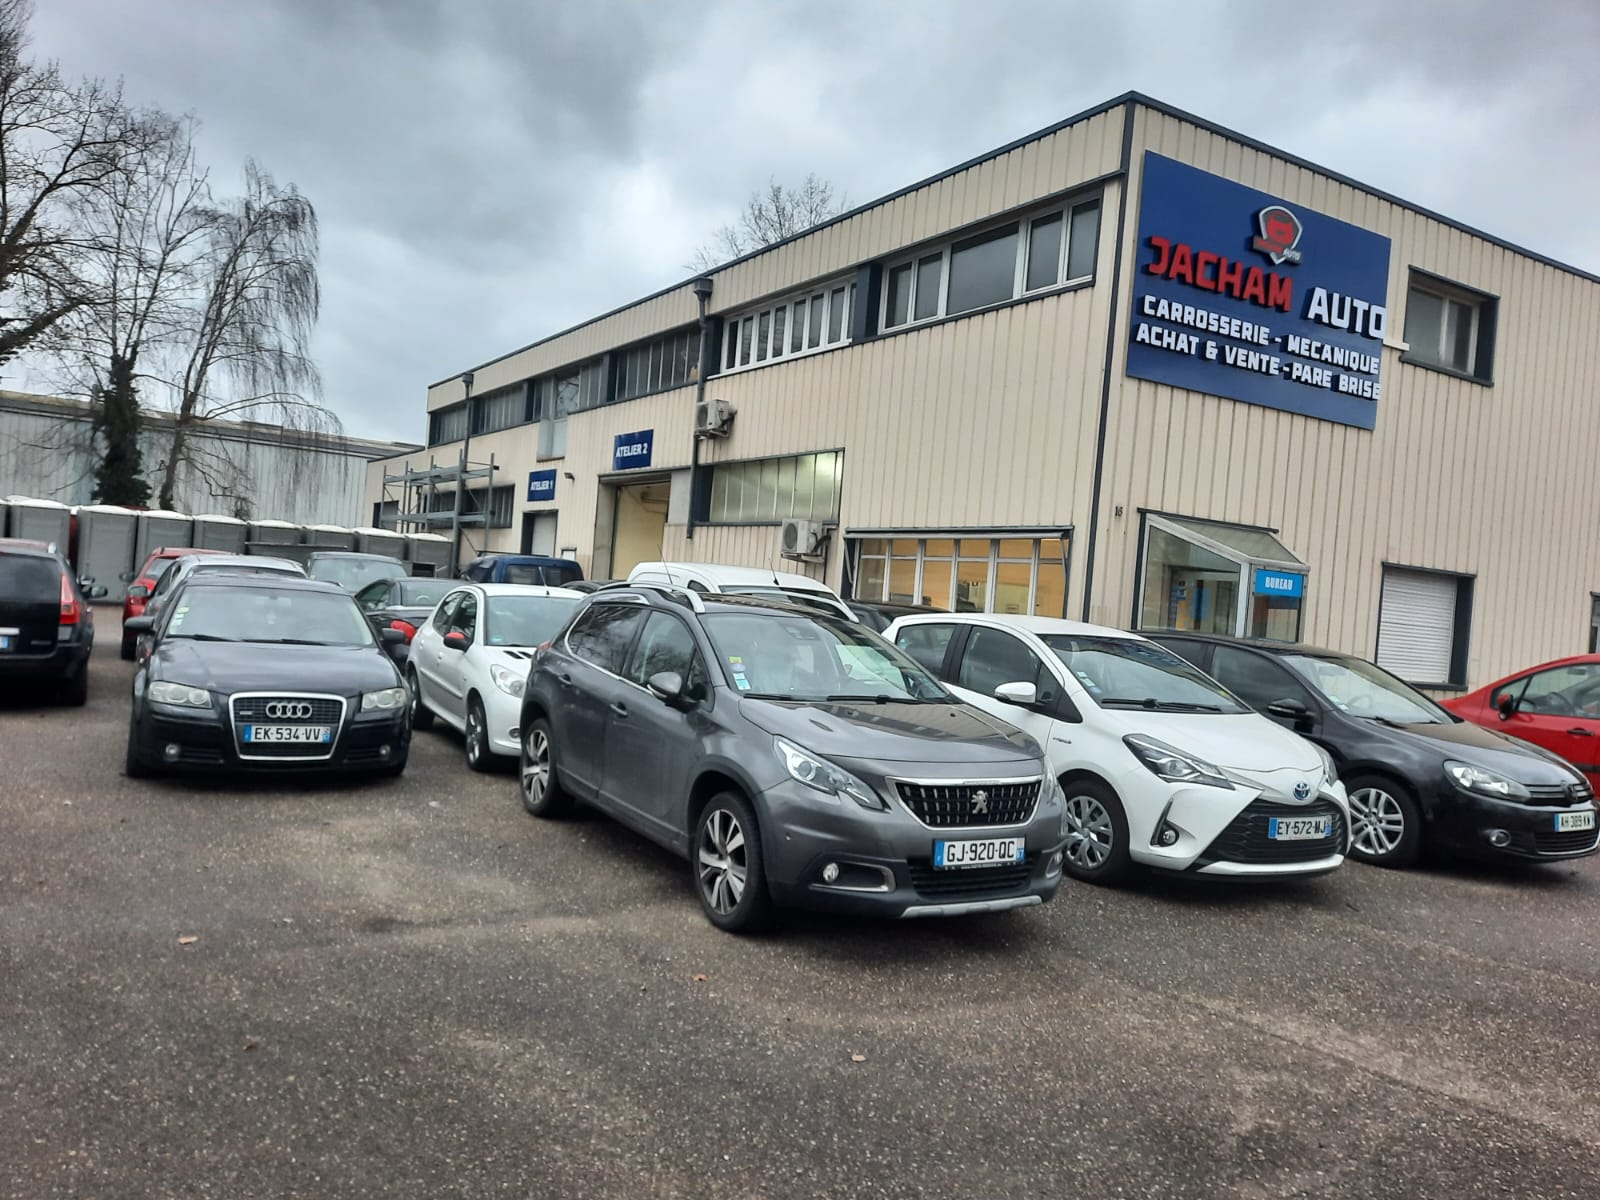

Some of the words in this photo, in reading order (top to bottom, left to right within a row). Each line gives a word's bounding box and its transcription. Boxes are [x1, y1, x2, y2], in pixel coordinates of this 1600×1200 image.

[1148, 236, 1293, 311] JACHAM
[1307, 287, 1386, 339] AUTO
[1143, 294, 1270, 346] CARROSSERIE
[1287, 334, 1380, 374] MECANIQUE
[1136, 323, 1199, 355] ACHAT
[1205, 340, 1219, 360] &
[1338, 374, 1381, 400] BRISE
[615, 443, 642, 458] ATELIER
[642, 442, 648, 454] 2
[530, 480, 550, 491] ATELIER
[1264, 576, 1293, 591] BUREAU
